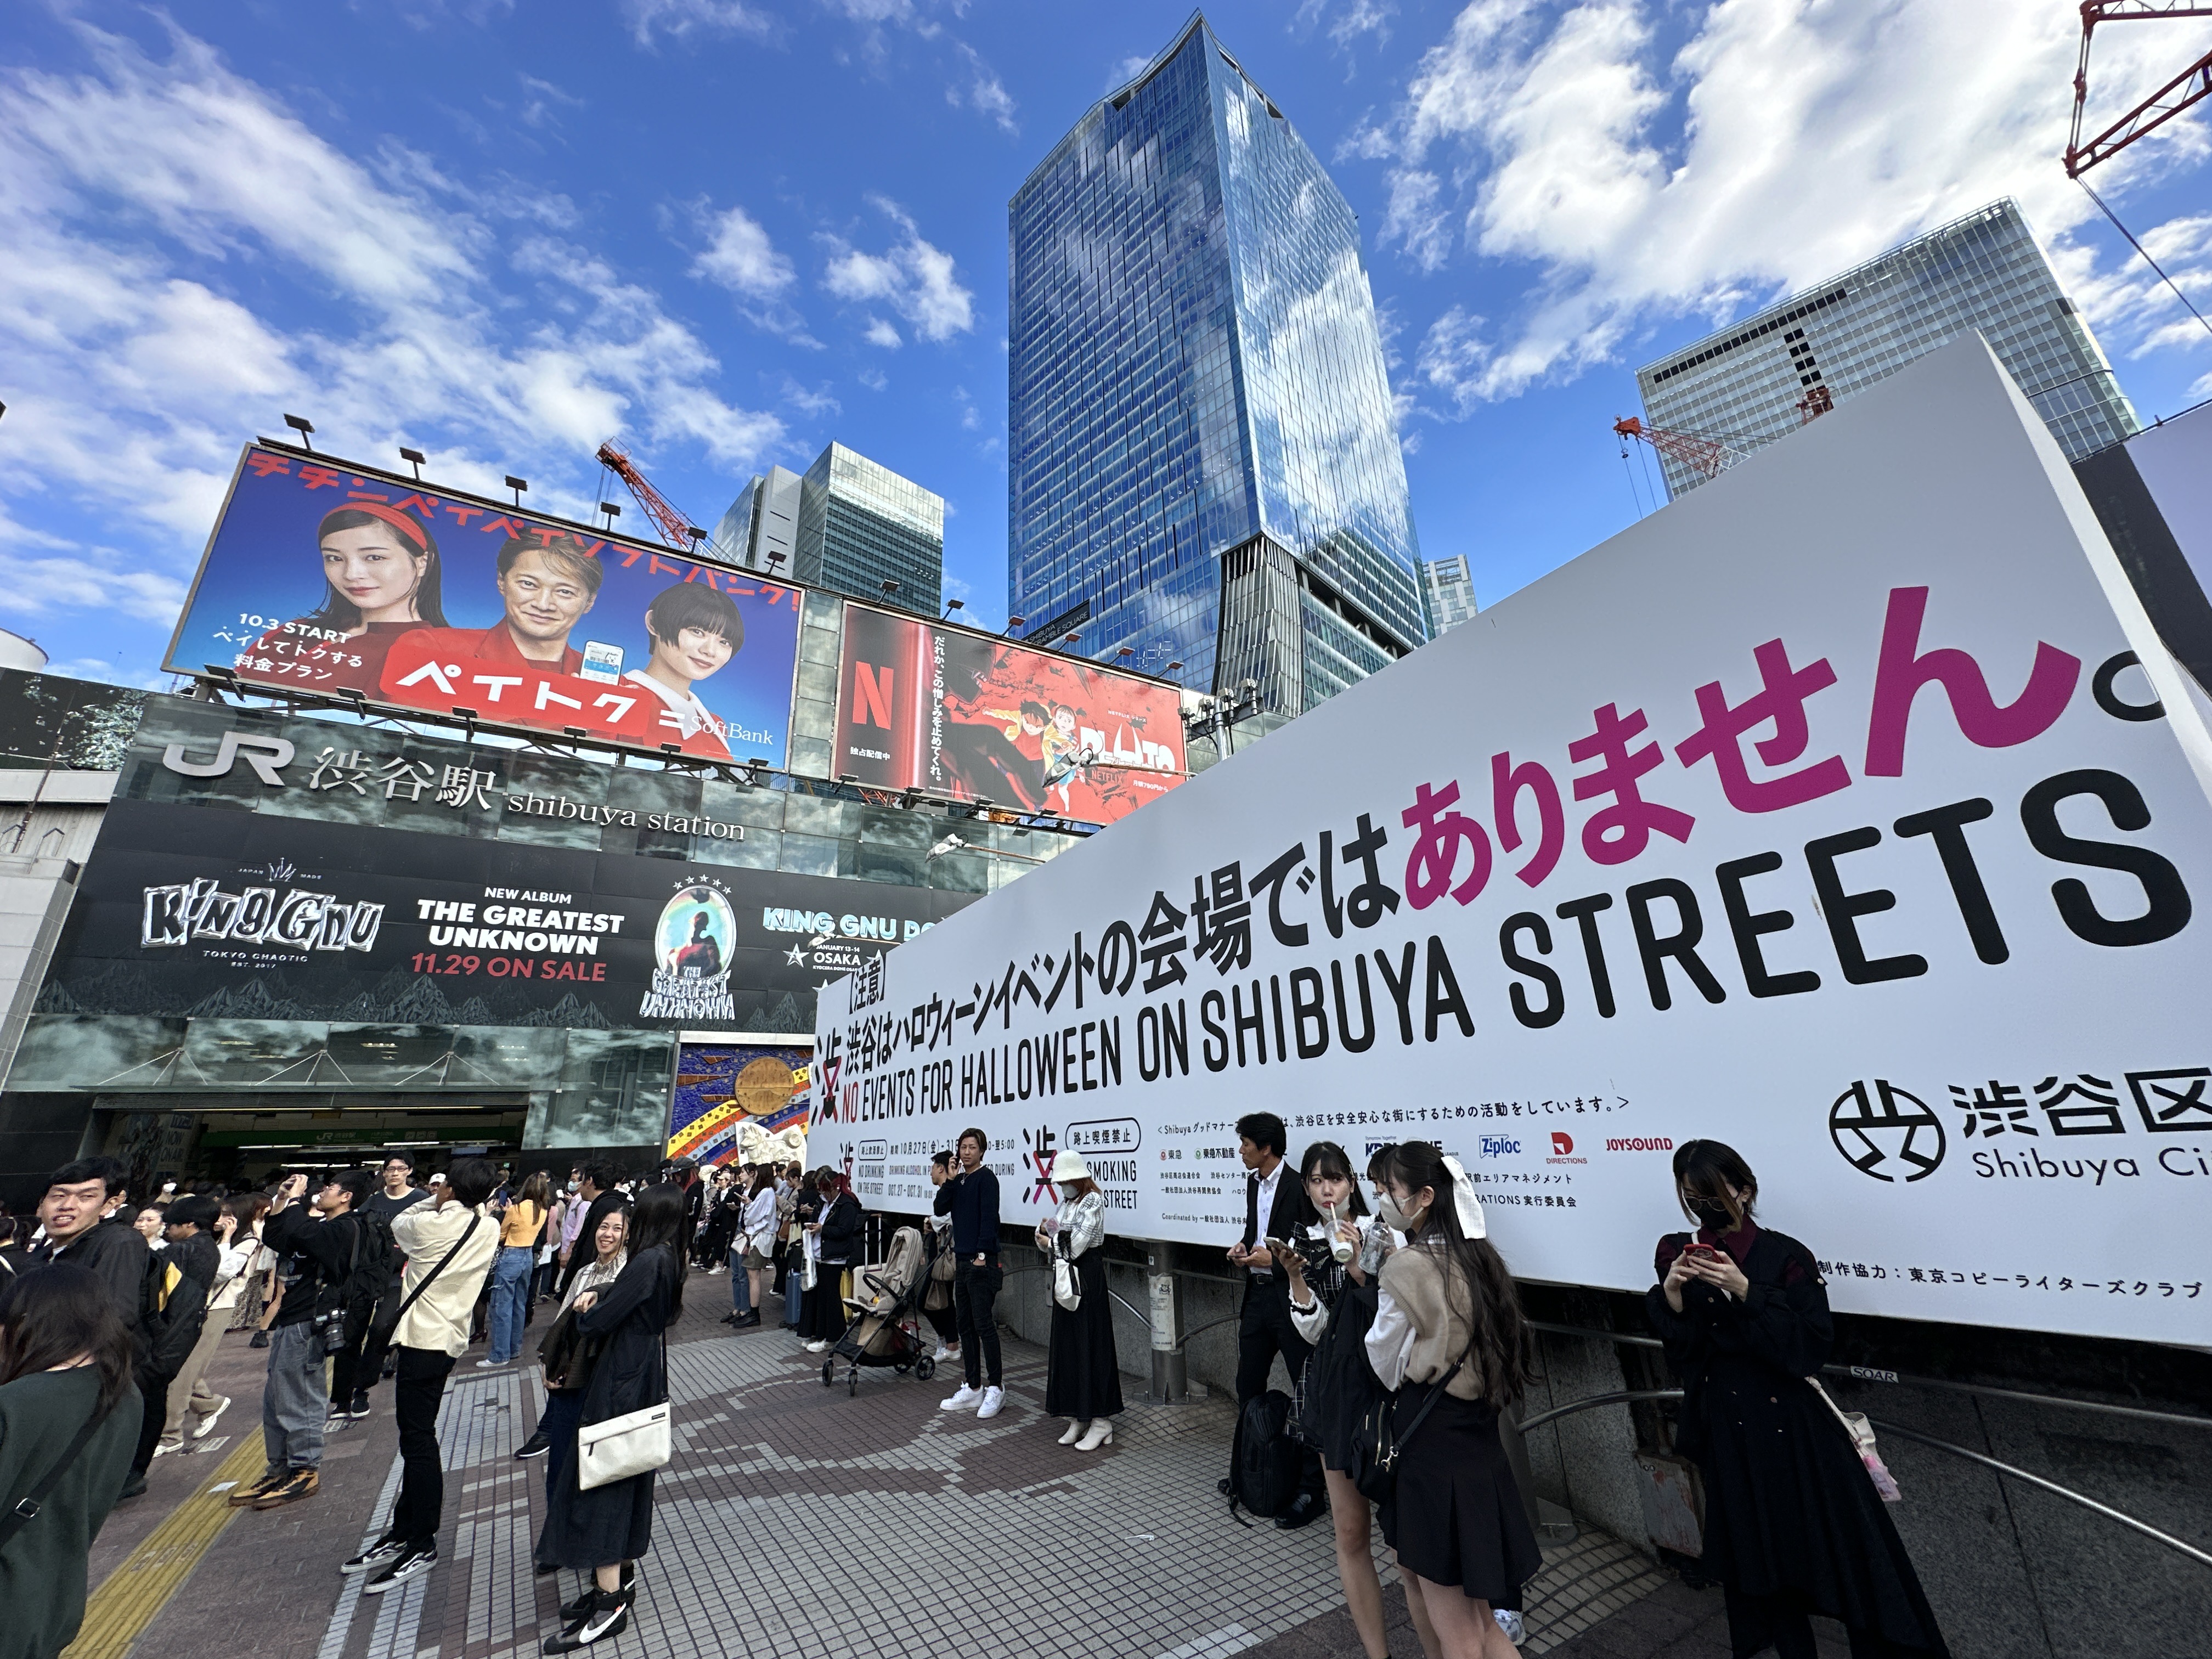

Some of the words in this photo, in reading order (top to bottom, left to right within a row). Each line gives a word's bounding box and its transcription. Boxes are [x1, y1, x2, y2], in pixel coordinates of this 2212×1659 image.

[240, 613, 279, 630] 10.3
[283, 622, 351, 644] START
[1062, 611, 1088, 631] SQUARE
[1029, 624, 1056, 643] SHIBUYA
[213, 627, 362, 667] ペイしてトクする
[233, 653, 332, 680] 料金プラン
[396, 659, 637, 723] ペイトク
[930, 636, 945, 781] だれか、この憎しみを止めてくれ。
[690, 716, 774, 746] SoftBank
[850, 746, 891, 761] 独占配信中
[1080, 723, 1176, 778] PLUTO
[163, 731, 295, 787] JR
[308, 747, 496, 811] 渋谷駅
[507, 792, 637, 828] shibuya
[647, 809, 745, 842] station
[484, 887, 519, 900] NEW
[523, 890, 572, 904] ALBUM
[417, 899, 476, 923] THE
[483, 905, 625, 933] GREATEST
[763, 907, 836, 934] KING
[839, 914, 897, 941] GNU
[428, 925, 599, 955] UNKNOWN
[842, 1081, 859, 1124] NO
[862, 1068, 915, 1121] EVENTS
[921, 1059, 952, 1114] FOR
[961, 1015, 1121, 1108] HALLOWEEN
[1137, 998, 1189, 1082] ON
[1200, 935, 1476, 1071] SHIBUYA
[1499, 769, 2192, 1029] STREETS
[202, 950, 246, 959] TOKYO
[252, 953, 308, 963] CHAOTIC
[411, 952, 481, 975] 11.29
[487, 957, 534, 978] ON
[540, 960, 607, 981] SALE
[814, 952, 861, 966] OSAKA
[1948, 1067, 2212, 1139] 渋谷区
[1074, 1128, 1131, 1146] 路上喫煙禁止
[1193, 1121, 1238, 1132] グッドマナー
[1168, 1149, 1182, 1159] 東急
[1203, 1148, 1235, 1159] 東急不動産
[1481, 1138, 1521, 1158] Ziploc
[1606, 1137, 1673, 1151] JOYSOUND
[865, 1165, 884, 1178] DRINKING
[995, 1163, 1014, 1176] DURING
[1087, 1160, 1137, 1182] SMOKING
[1972, 1148, 2140, 1186] Shibuya
[1104, 1189, 1137, 1210] STREET
[1523, 1195, 1577, 1207] 実行委員会
[1852, 1366, 1897, 1383] SOAR
